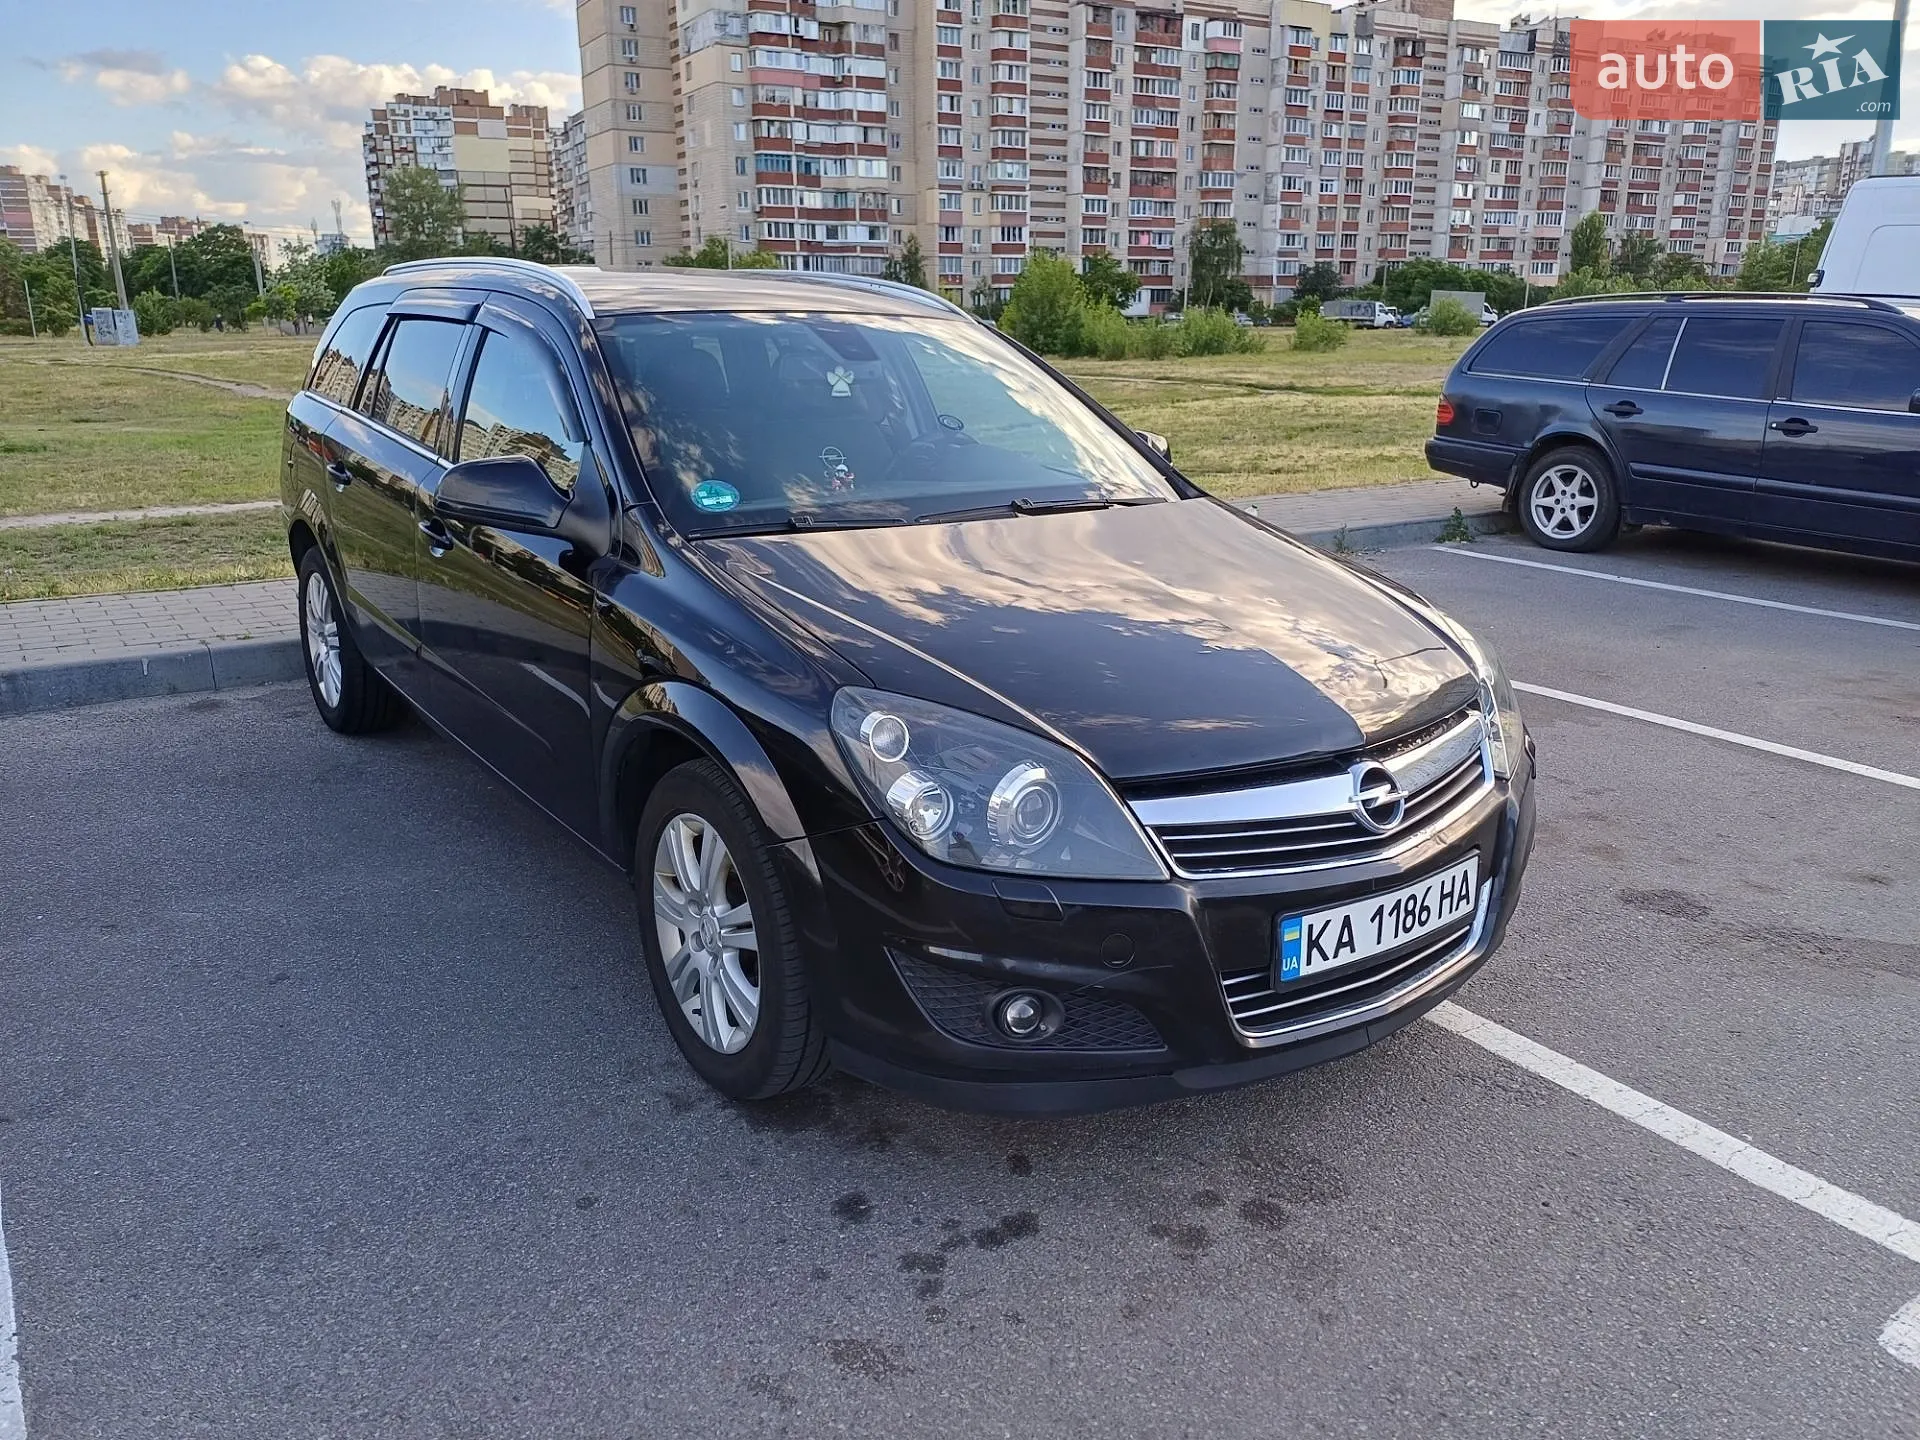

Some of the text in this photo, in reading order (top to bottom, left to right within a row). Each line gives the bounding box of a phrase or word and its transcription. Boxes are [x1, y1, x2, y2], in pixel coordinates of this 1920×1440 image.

[1305, 869, 1471, 967] KA 1186 HA
[1282, 958, 1299, 972] UA
